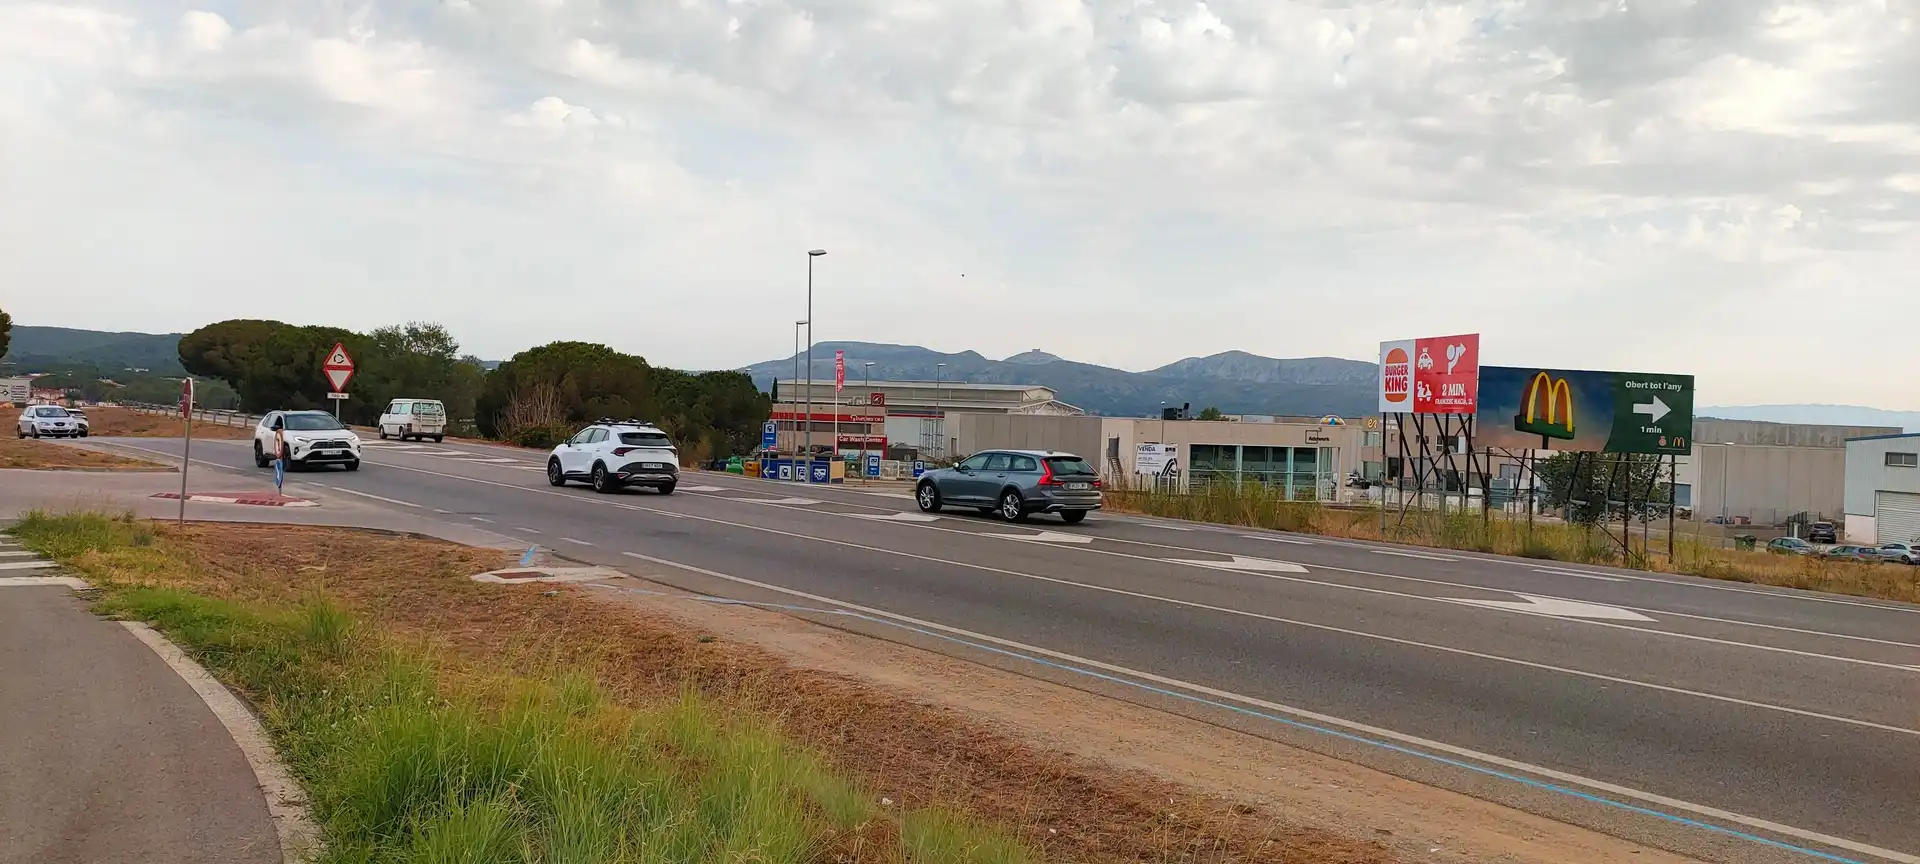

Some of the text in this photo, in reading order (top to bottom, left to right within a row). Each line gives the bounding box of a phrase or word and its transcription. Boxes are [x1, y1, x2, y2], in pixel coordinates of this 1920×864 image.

[1385, 364, 1408, 376] BURGER
[1385, 376, 1408, 392] KING
[1442, 383, 1466, 396] 2 MIN.
[1625, 381, 1682, 392] Obert tot l'any
[1640, 425, 1662, 433] 1 min
